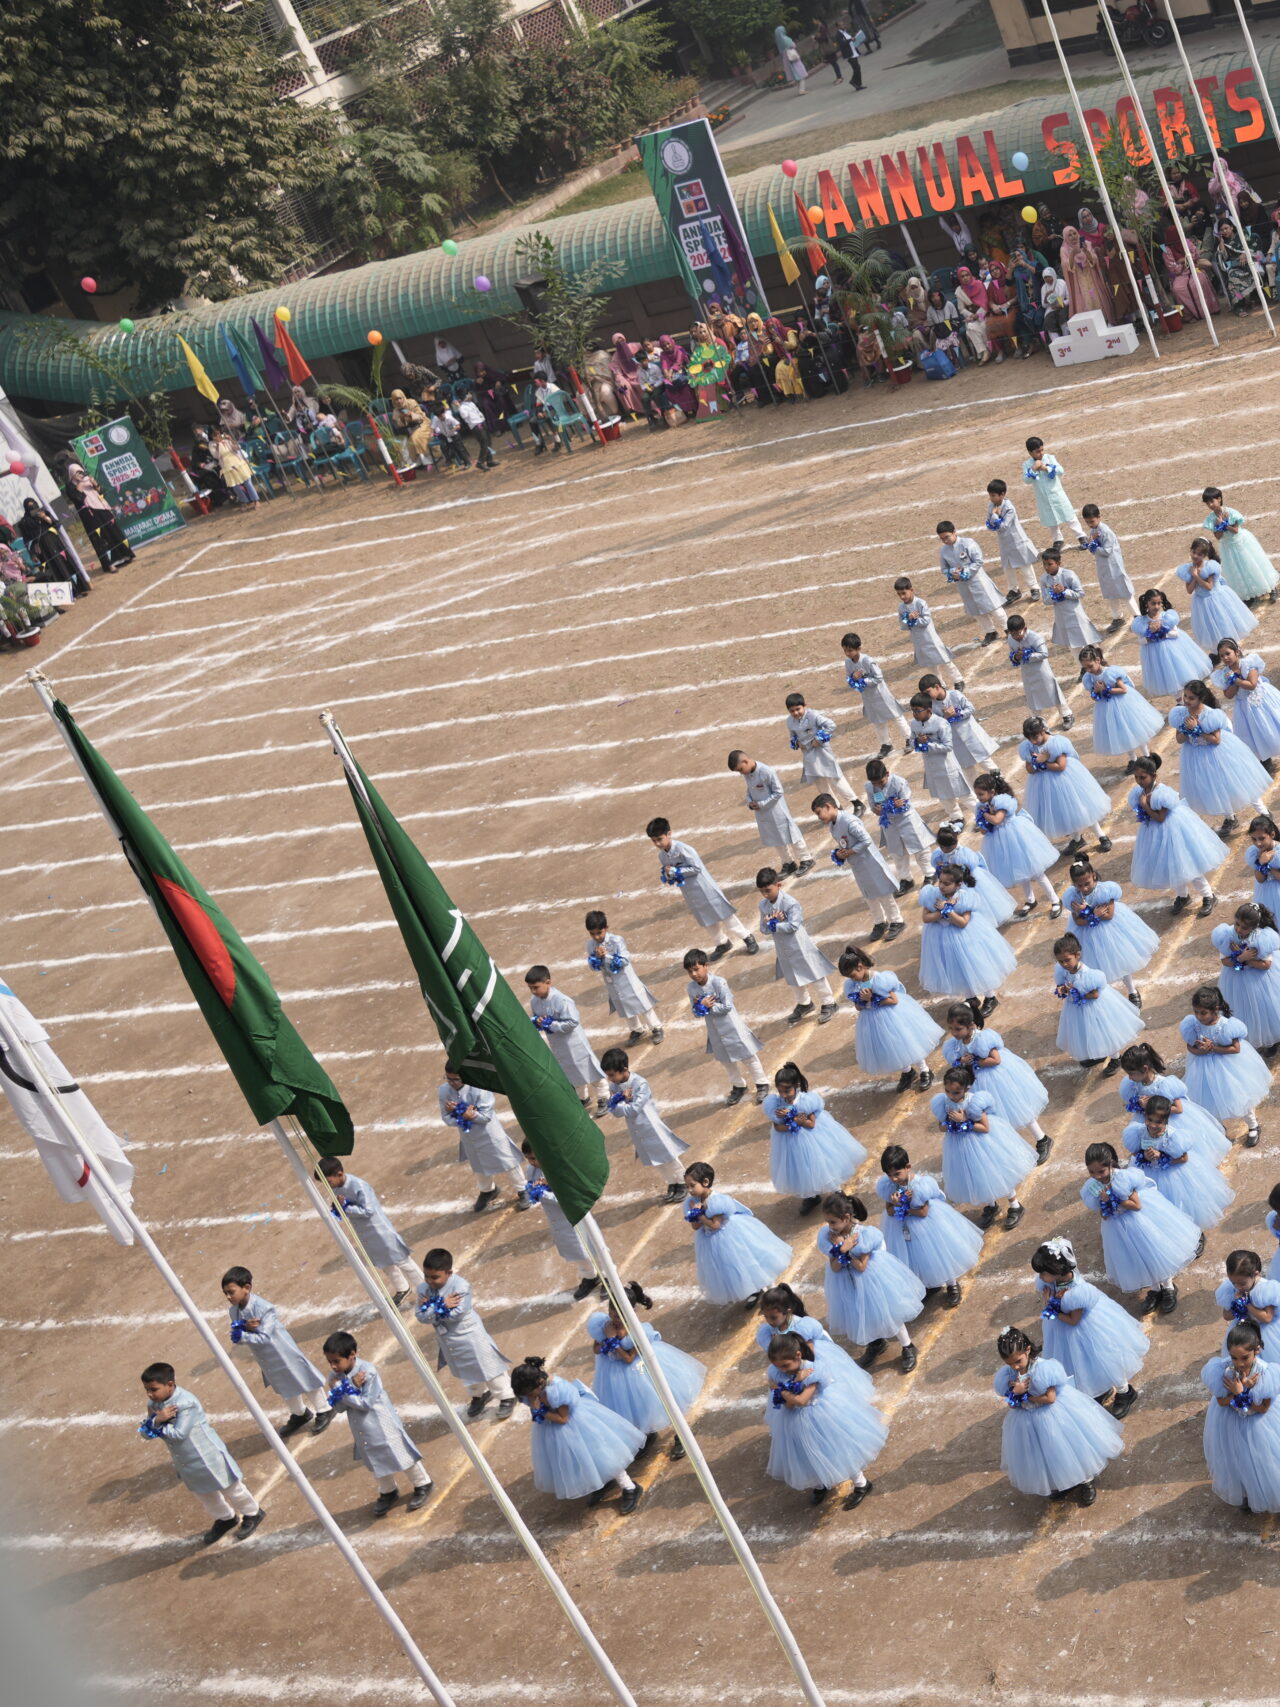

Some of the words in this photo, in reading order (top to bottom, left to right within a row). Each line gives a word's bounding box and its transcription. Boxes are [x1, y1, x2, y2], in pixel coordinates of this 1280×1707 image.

[818, 130, 1024, 239] ANNUAL
[1041, 66, 1265, 186] SPORTS
[1105, 336, 1121, 349] 2nd
[1057, 345, 1072, 358] 3rd
[104, 454, 133, 471] ANNUAL
[108, 461, 138, 478] SPORTS
